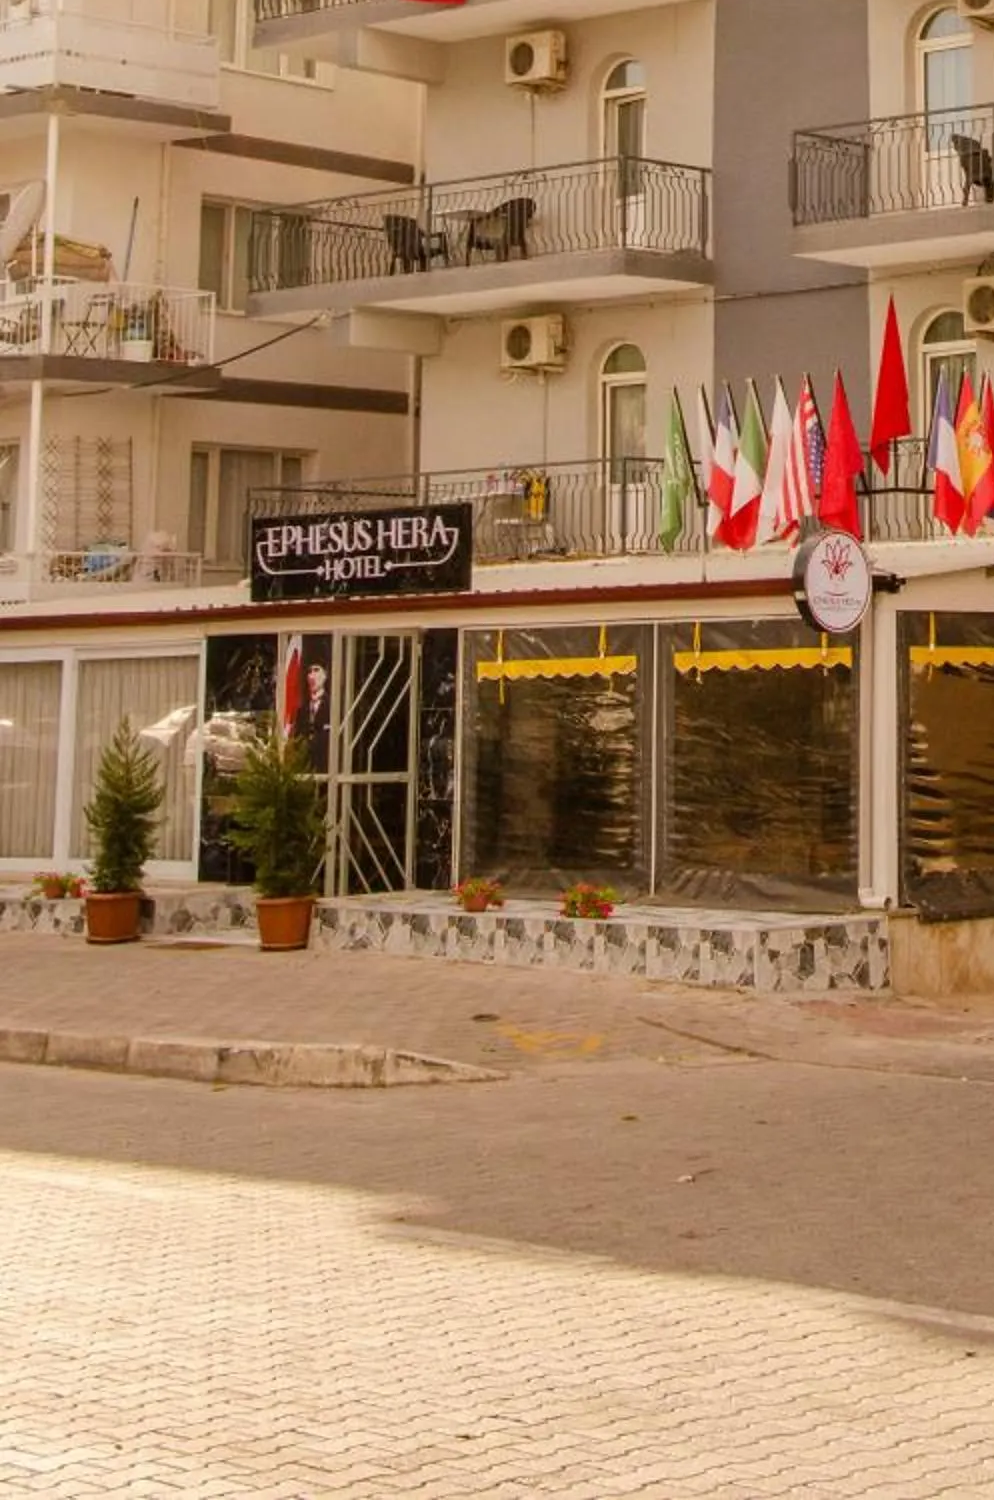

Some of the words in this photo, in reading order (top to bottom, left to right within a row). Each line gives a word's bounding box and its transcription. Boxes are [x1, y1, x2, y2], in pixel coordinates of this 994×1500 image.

[267, 519, 371, 557] EPHESUS
[377, 515, 449, 550] HERA
[323, 555, 387, 581] HOTEL
